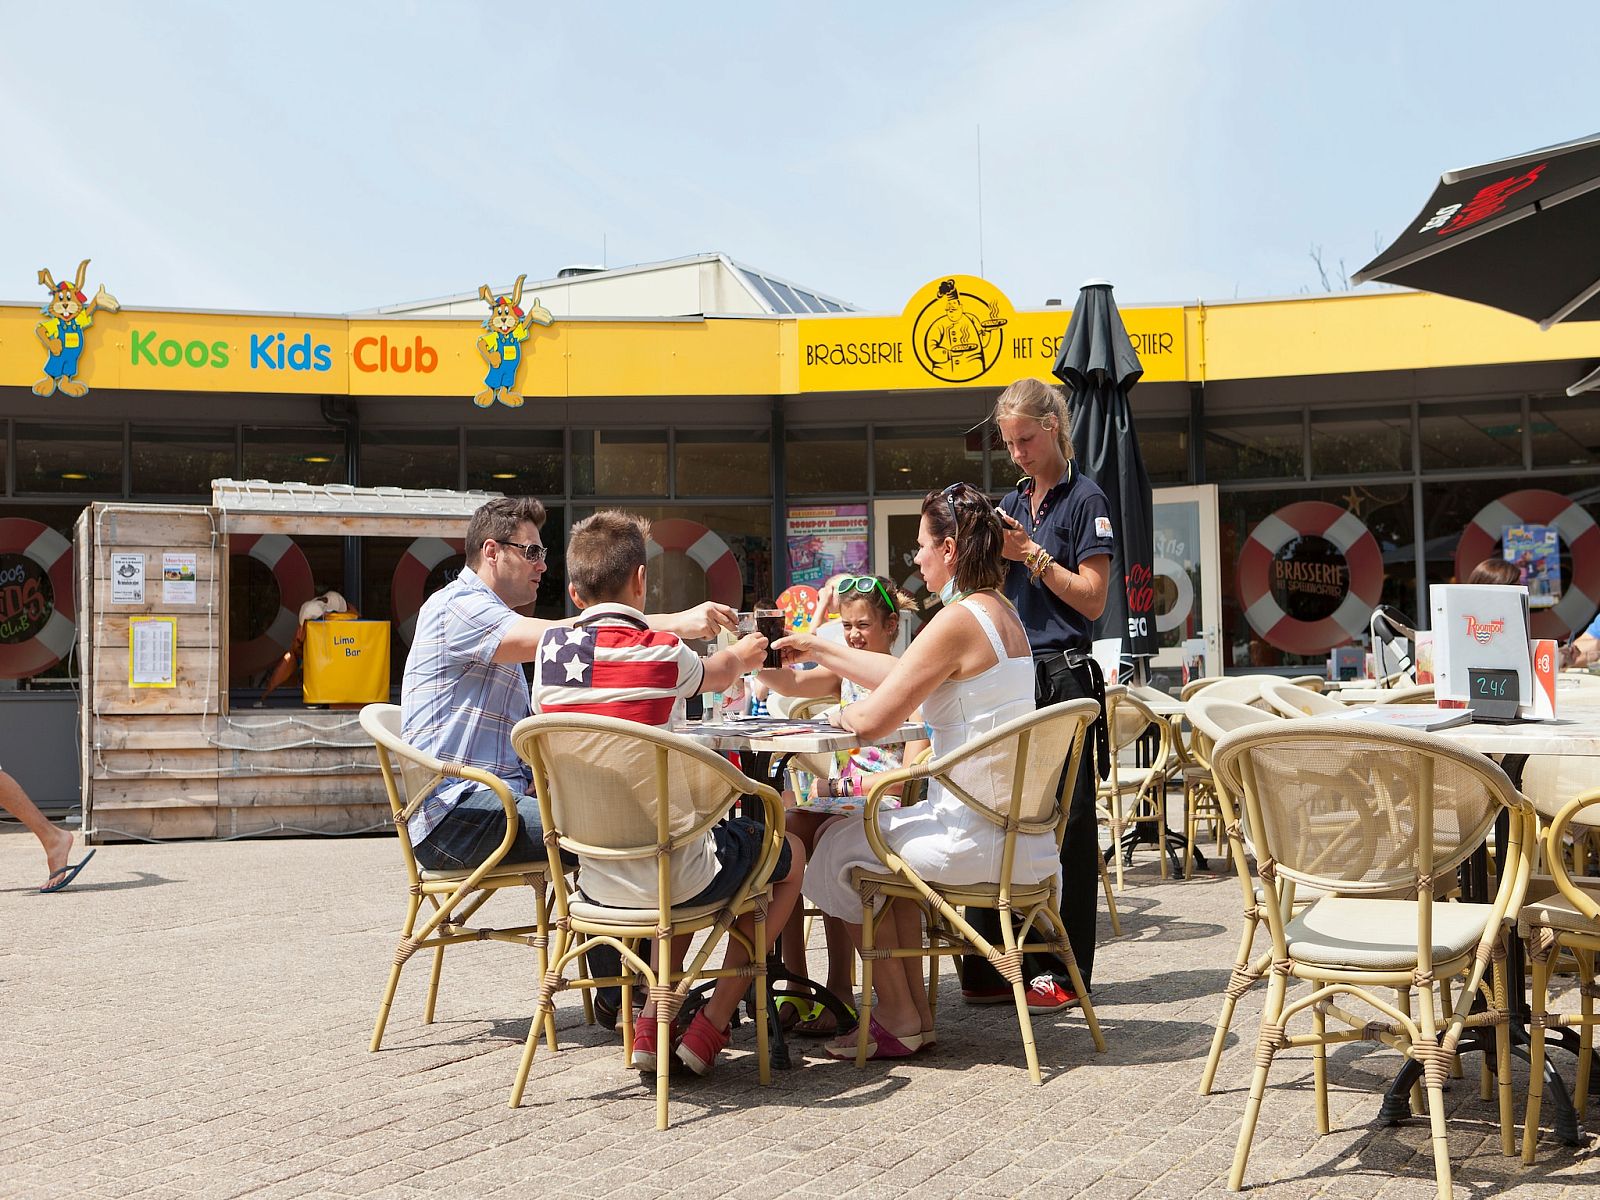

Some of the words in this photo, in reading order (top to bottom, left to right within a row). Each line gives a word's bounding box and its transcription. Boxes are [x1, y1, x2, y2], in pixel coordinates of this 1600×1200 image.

[131, 330, 229, 369] Koos
[250, 332, 332, 372] Kids
[353, 335, 438, 374] Club
[1013, 337, 1033, 359] HET
[1275, 560, 1344, 586] BRASSERIE
[1128, 617, 1148, 638] ero
[1462, 615, 1505, 644] Roompot
[333, 636, 355, 646] Limo
[345, 647, 361, 657] Bar
[1476, 677, 1507, 697] 246
